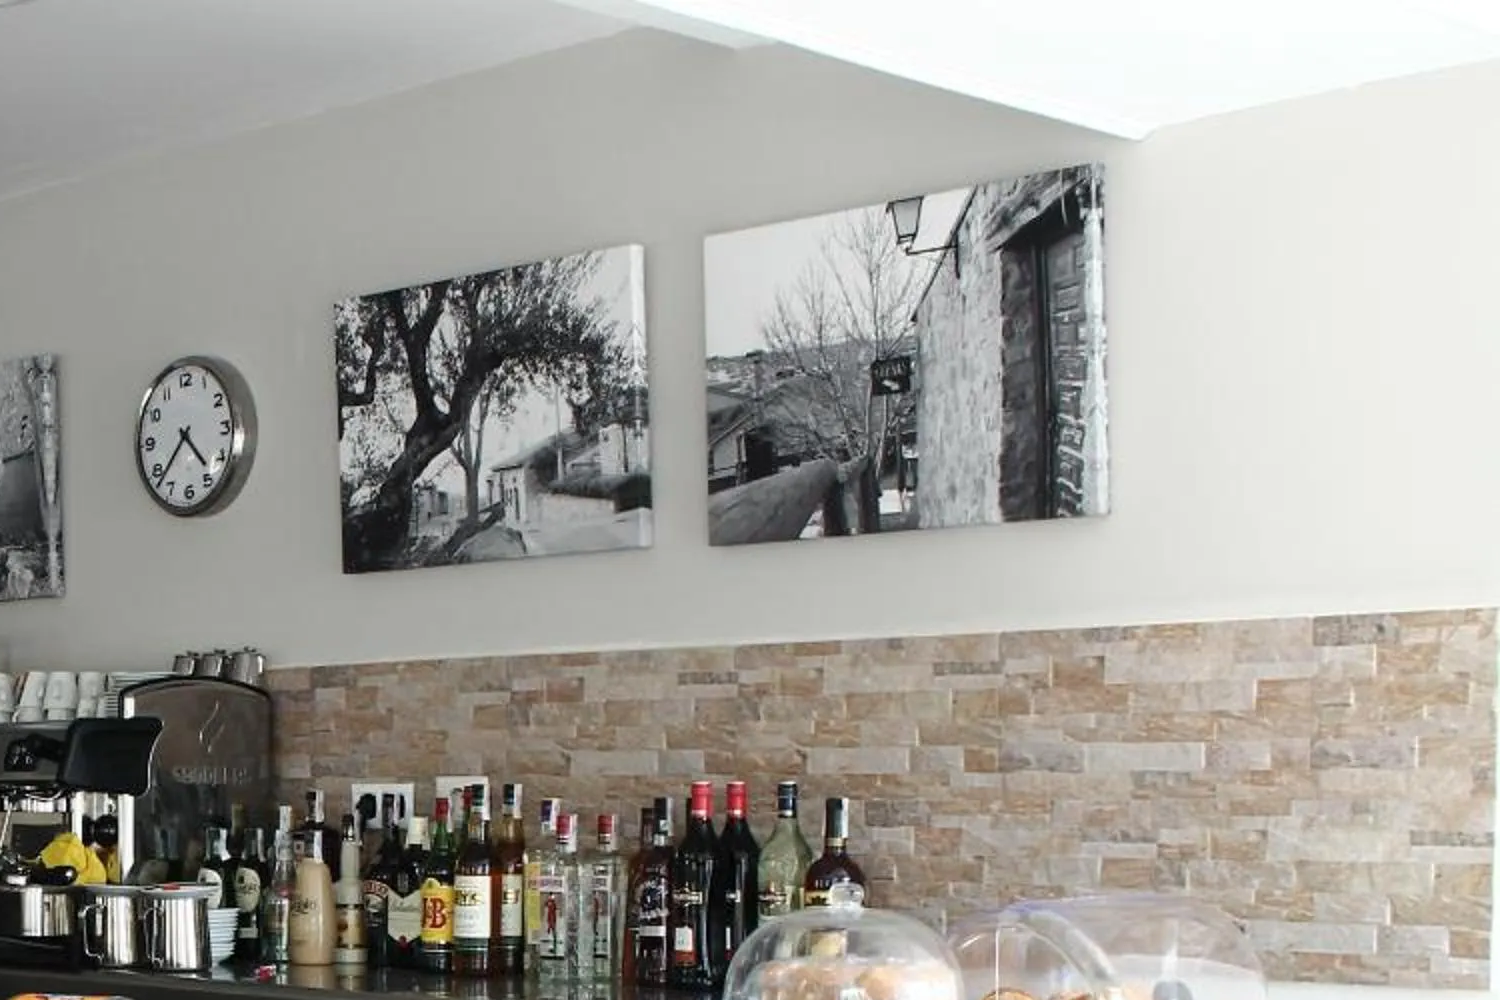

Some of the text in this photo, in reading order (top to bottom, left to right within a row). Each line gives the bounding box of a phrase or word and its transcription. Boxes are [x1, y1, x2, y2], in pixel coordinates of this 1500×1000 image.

[180, 373, 193, 389] 12
[202, 376, 207, 389] 1
[163, 387, 171, 401] 11
[214, 393, 223, 408] 2
[150, 408, 161, 422] 10
[220, 420, 230, 435] 3
[145, 437, 156, 451] 9
[152, 464, 163, 478] 8
[203, 473, 213, 488] 5
[166, 481, 175, 496] 7
[184, 485, 195, 499] 6
